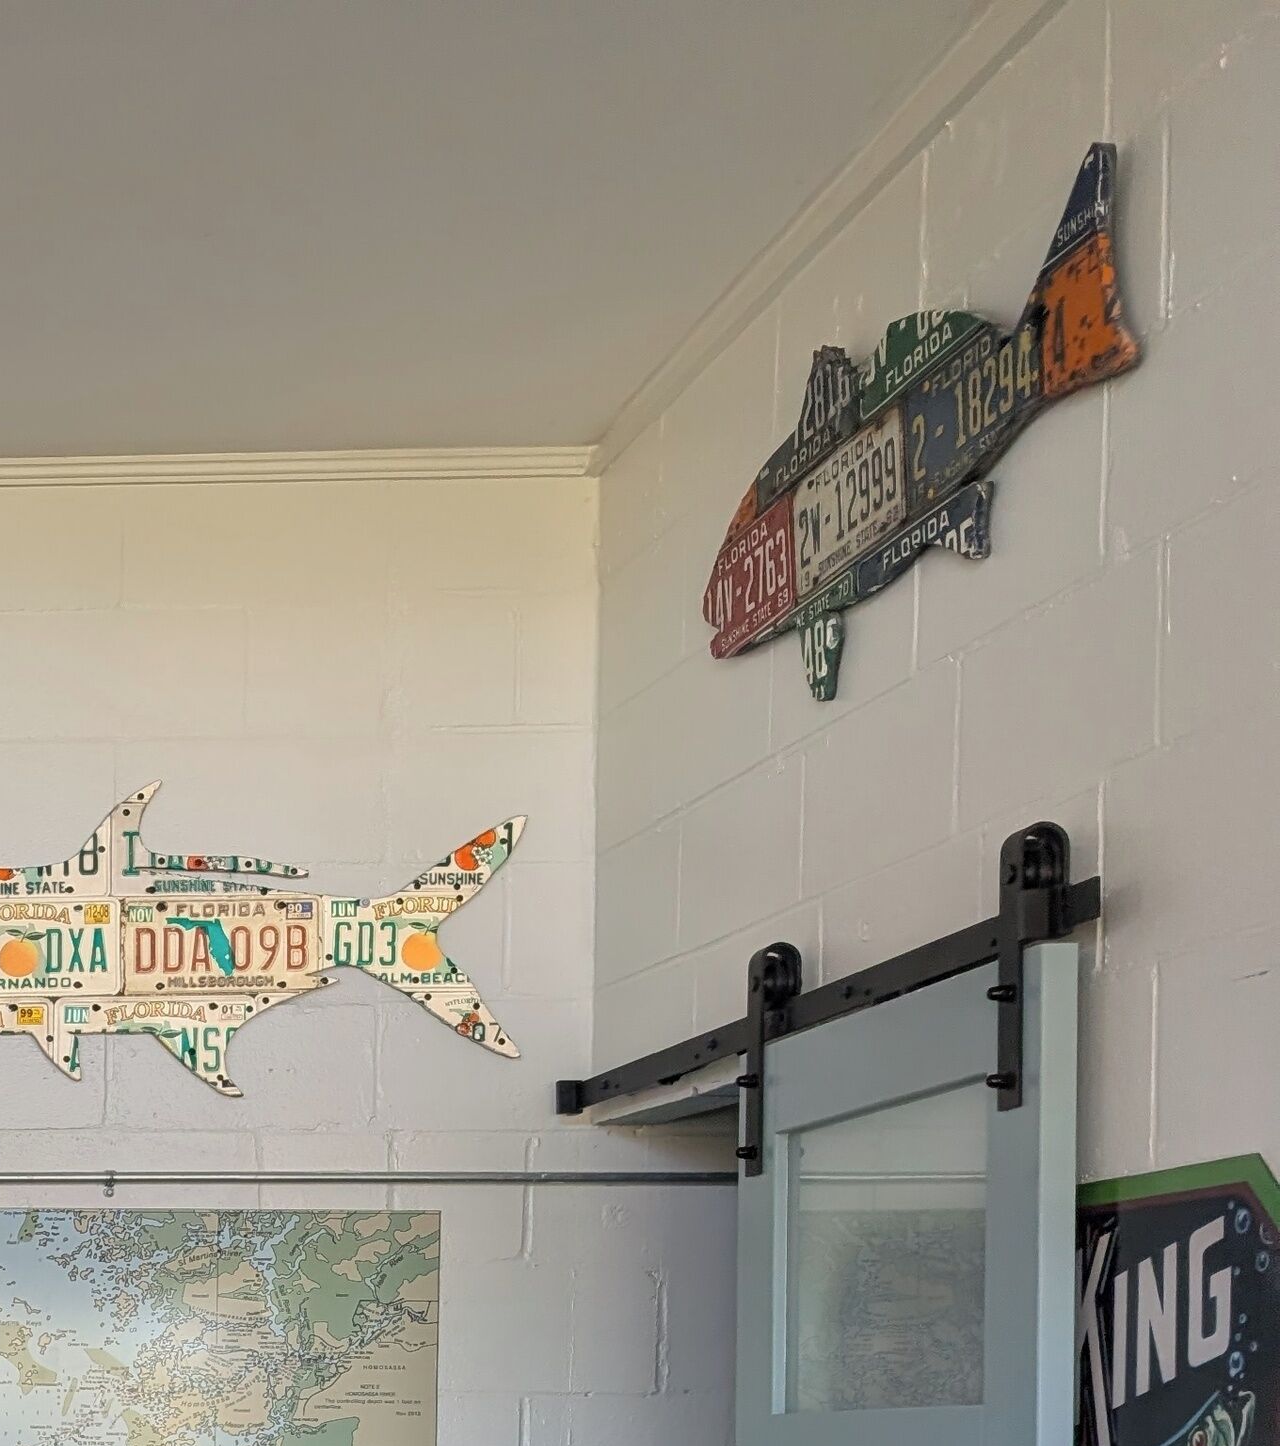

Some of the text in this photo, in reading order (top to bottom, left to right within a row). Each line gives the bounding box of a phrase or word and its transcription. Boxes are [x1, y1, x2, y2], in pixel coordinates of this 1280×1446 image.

[885, 322, 952, 393] FLORIDA
[932, 334, 991, 399] FLORID
[774, 428, 831, 484] FLORIDA
[815, 431, 875, 493] FLORIDA
[798, 437, 897, 569] 2W-12999
[717, 522, 768, 577] FLORIDA
[883, 510, 950, 571] FLORIDA
[808, 594, 830, 621] STATE
[838, 581, 850, 600] 70
[721, 618, 750, 653] SUNSHINE
[753, 601, 772, 627] STATE
[777, 588, 789, 607] 69
[26, 881, 65, 895] STATE
[153, 880, 262, 893] SUNSHINE STAT
[418, 873, 485, 886] SUNSHINE
[129, 908, 153, 922] NOV
[176, 902, 265, 917] FLORIDA
[287, 904, 302, 914] 90
[332, 902, 355, 917] JUN
[373, 896, 462, 921] FLORID
[45, 927, 108, 974] DXA
[135, 925, 310, 974] DDA 09B
[333, 921, 397, 967] GD3
[167, 976, 274, 989] HILLSBOROUGH
[421, 972, 469, 984] BEAC
[19, 1008, 33, 1018] 99
[65, 1008, 89, 1023] JUN
[104, 1001, 208, 1025] FLORIDA
[221, 1005, 234, 1015] 01
[26, 1319, 42, 1327] Keys
